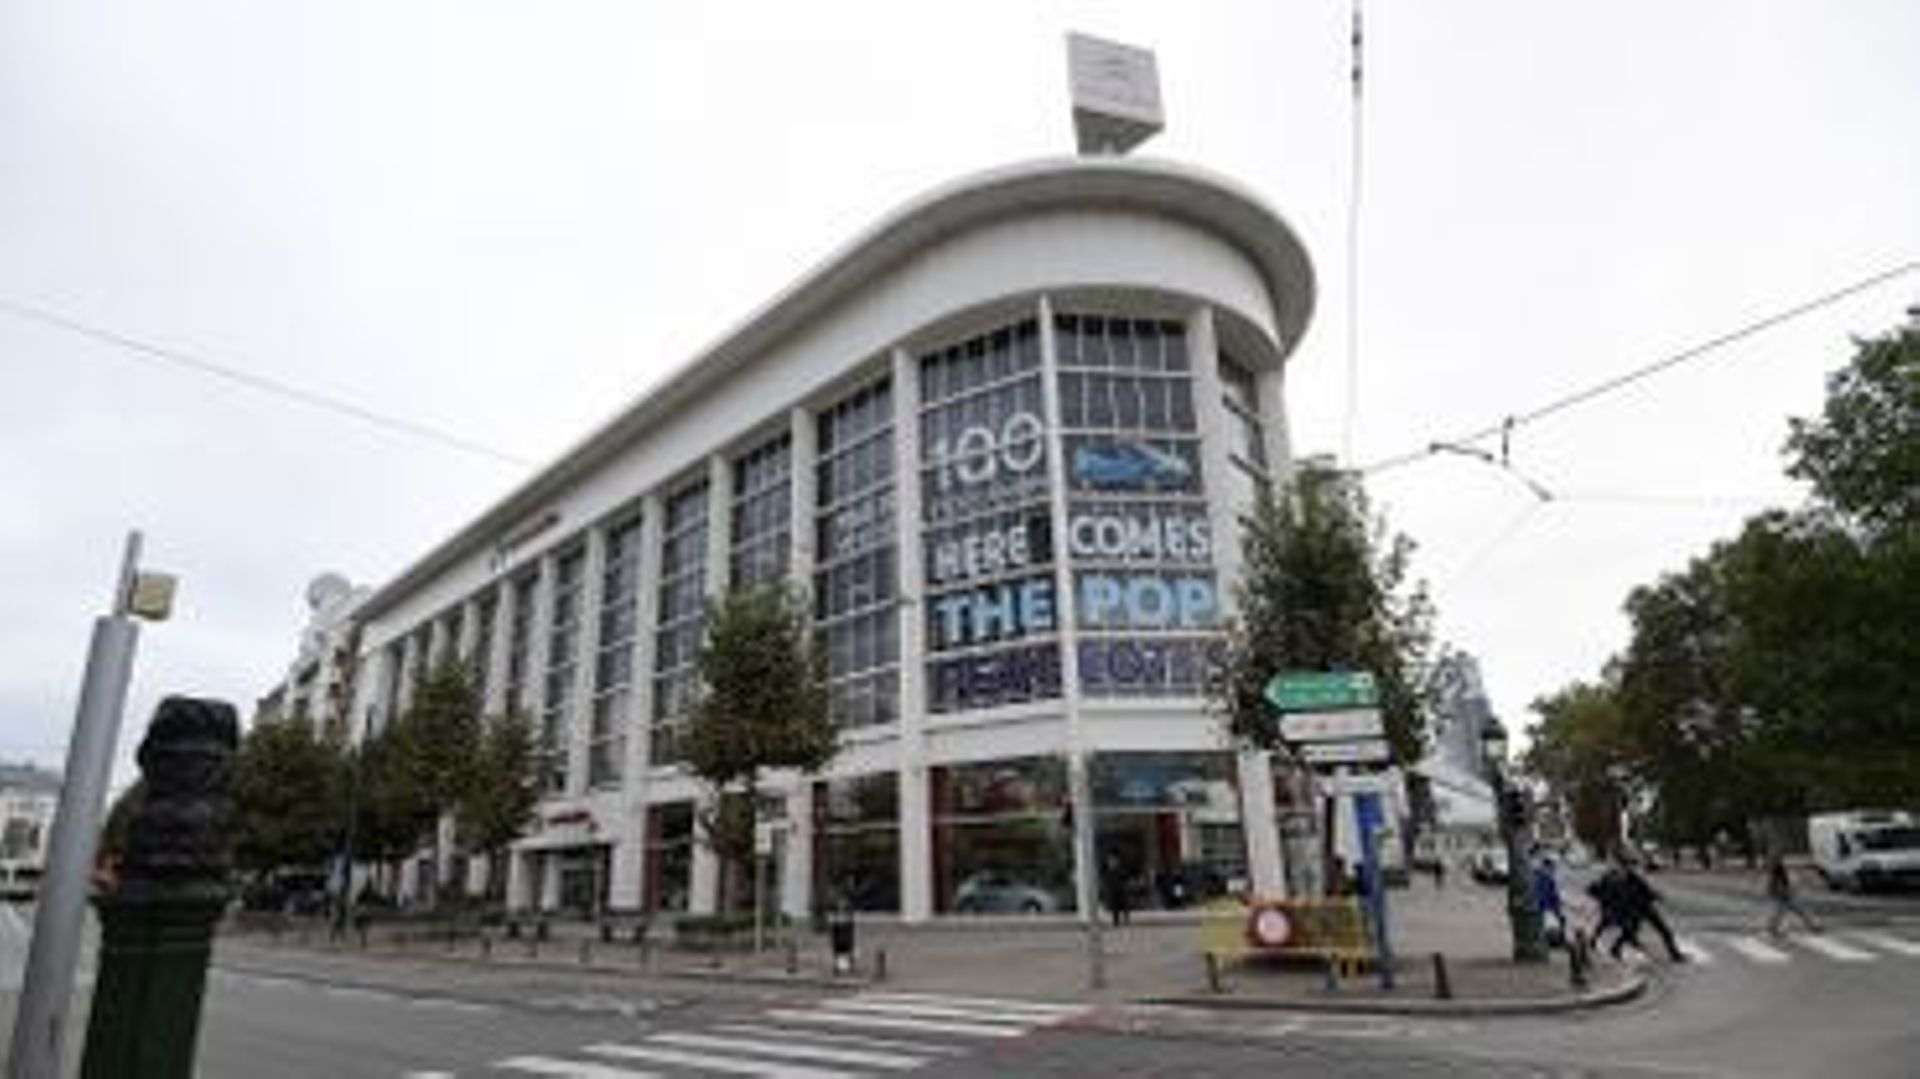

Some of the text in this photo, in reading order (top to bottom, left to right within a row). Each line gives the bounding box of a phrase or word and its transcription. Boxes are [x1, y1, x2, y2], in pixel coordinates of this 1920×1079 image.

[935, 411, 1043, 490] 100
[934, 515, 1210, 579] HERE COMES
[936, 576, 1215, 643] THE POP
